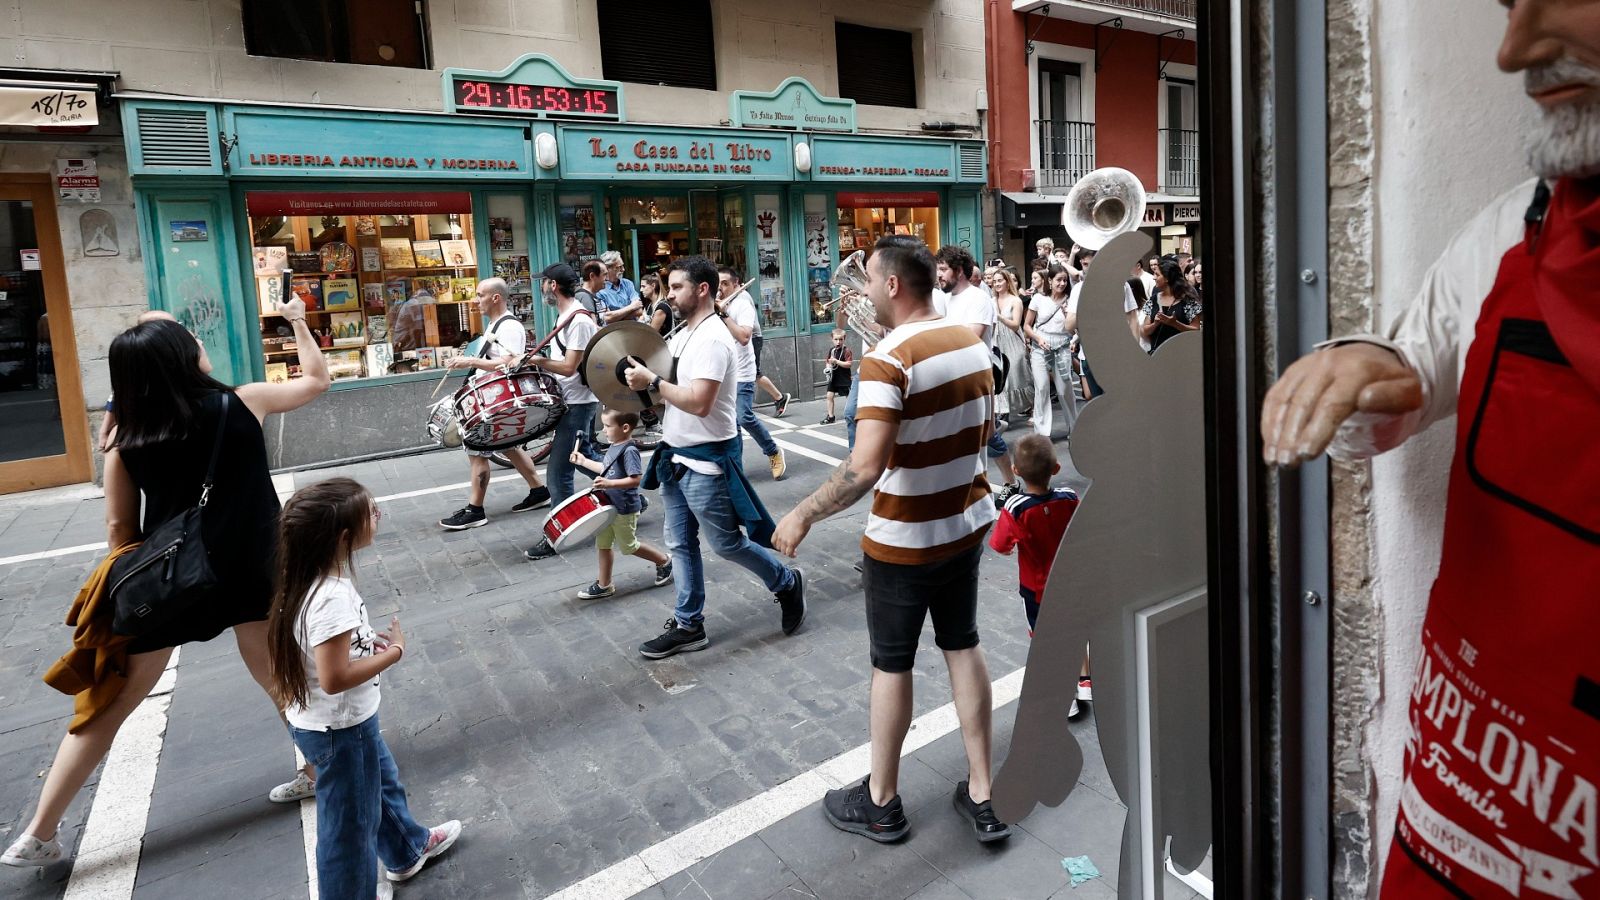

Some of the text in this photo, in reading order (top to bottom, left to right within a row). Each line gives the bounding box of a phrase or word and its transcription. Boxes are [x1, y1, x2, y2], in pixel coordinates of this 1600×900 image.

[31, 91, 87, 116] 18/70
[462, 82, 607, 114] 29:16:53:15
[588, 137, 772, 161] La Casa del Libro
[249, 154, 519, 171] LIBRERIA ANTIGUA Y MODERNA
[616, 162, 650, 172] CASA
[654, 163, 710, 173] FUNDADA
[713, 164, 727, 173] EN
[1457, 638, 1479, 668] THE
[1490, 698, 1526, 726] WEAR
